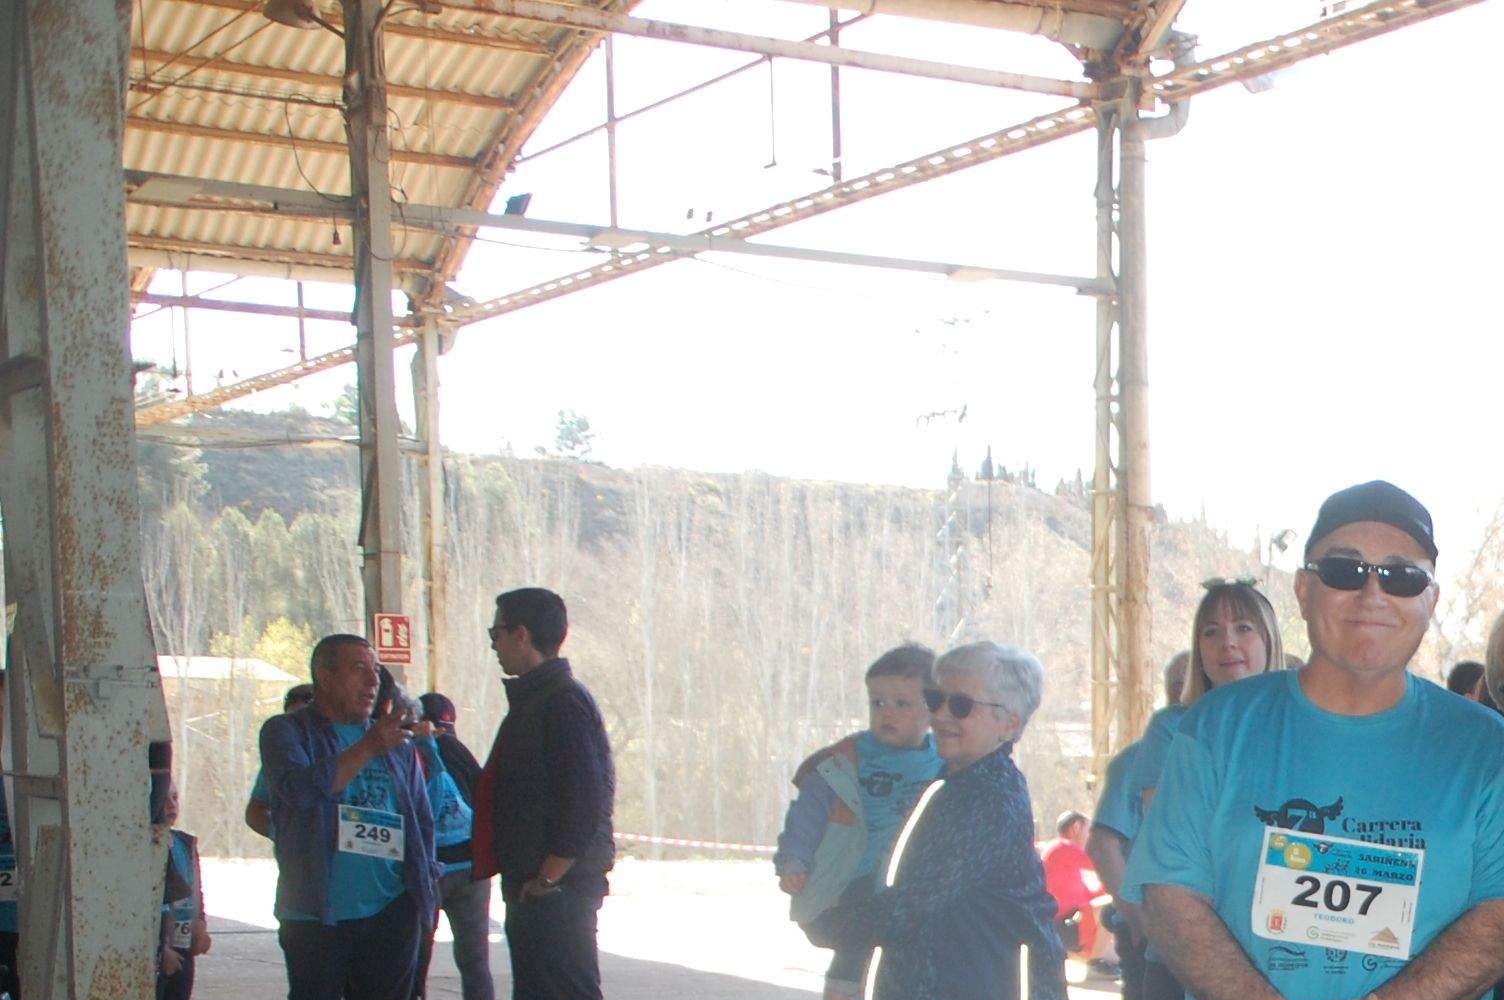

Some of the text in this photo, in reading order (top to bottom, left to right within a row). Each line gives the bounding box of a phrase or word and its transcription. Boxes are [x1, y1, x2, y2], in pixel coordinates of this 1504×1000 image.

[355, 824, 391, 843] 249
[1342, 816, 1423, 833] Carrera
[1373, 869, 1414, 881] MARZO
[1291, 875, 1383, 916] 207
